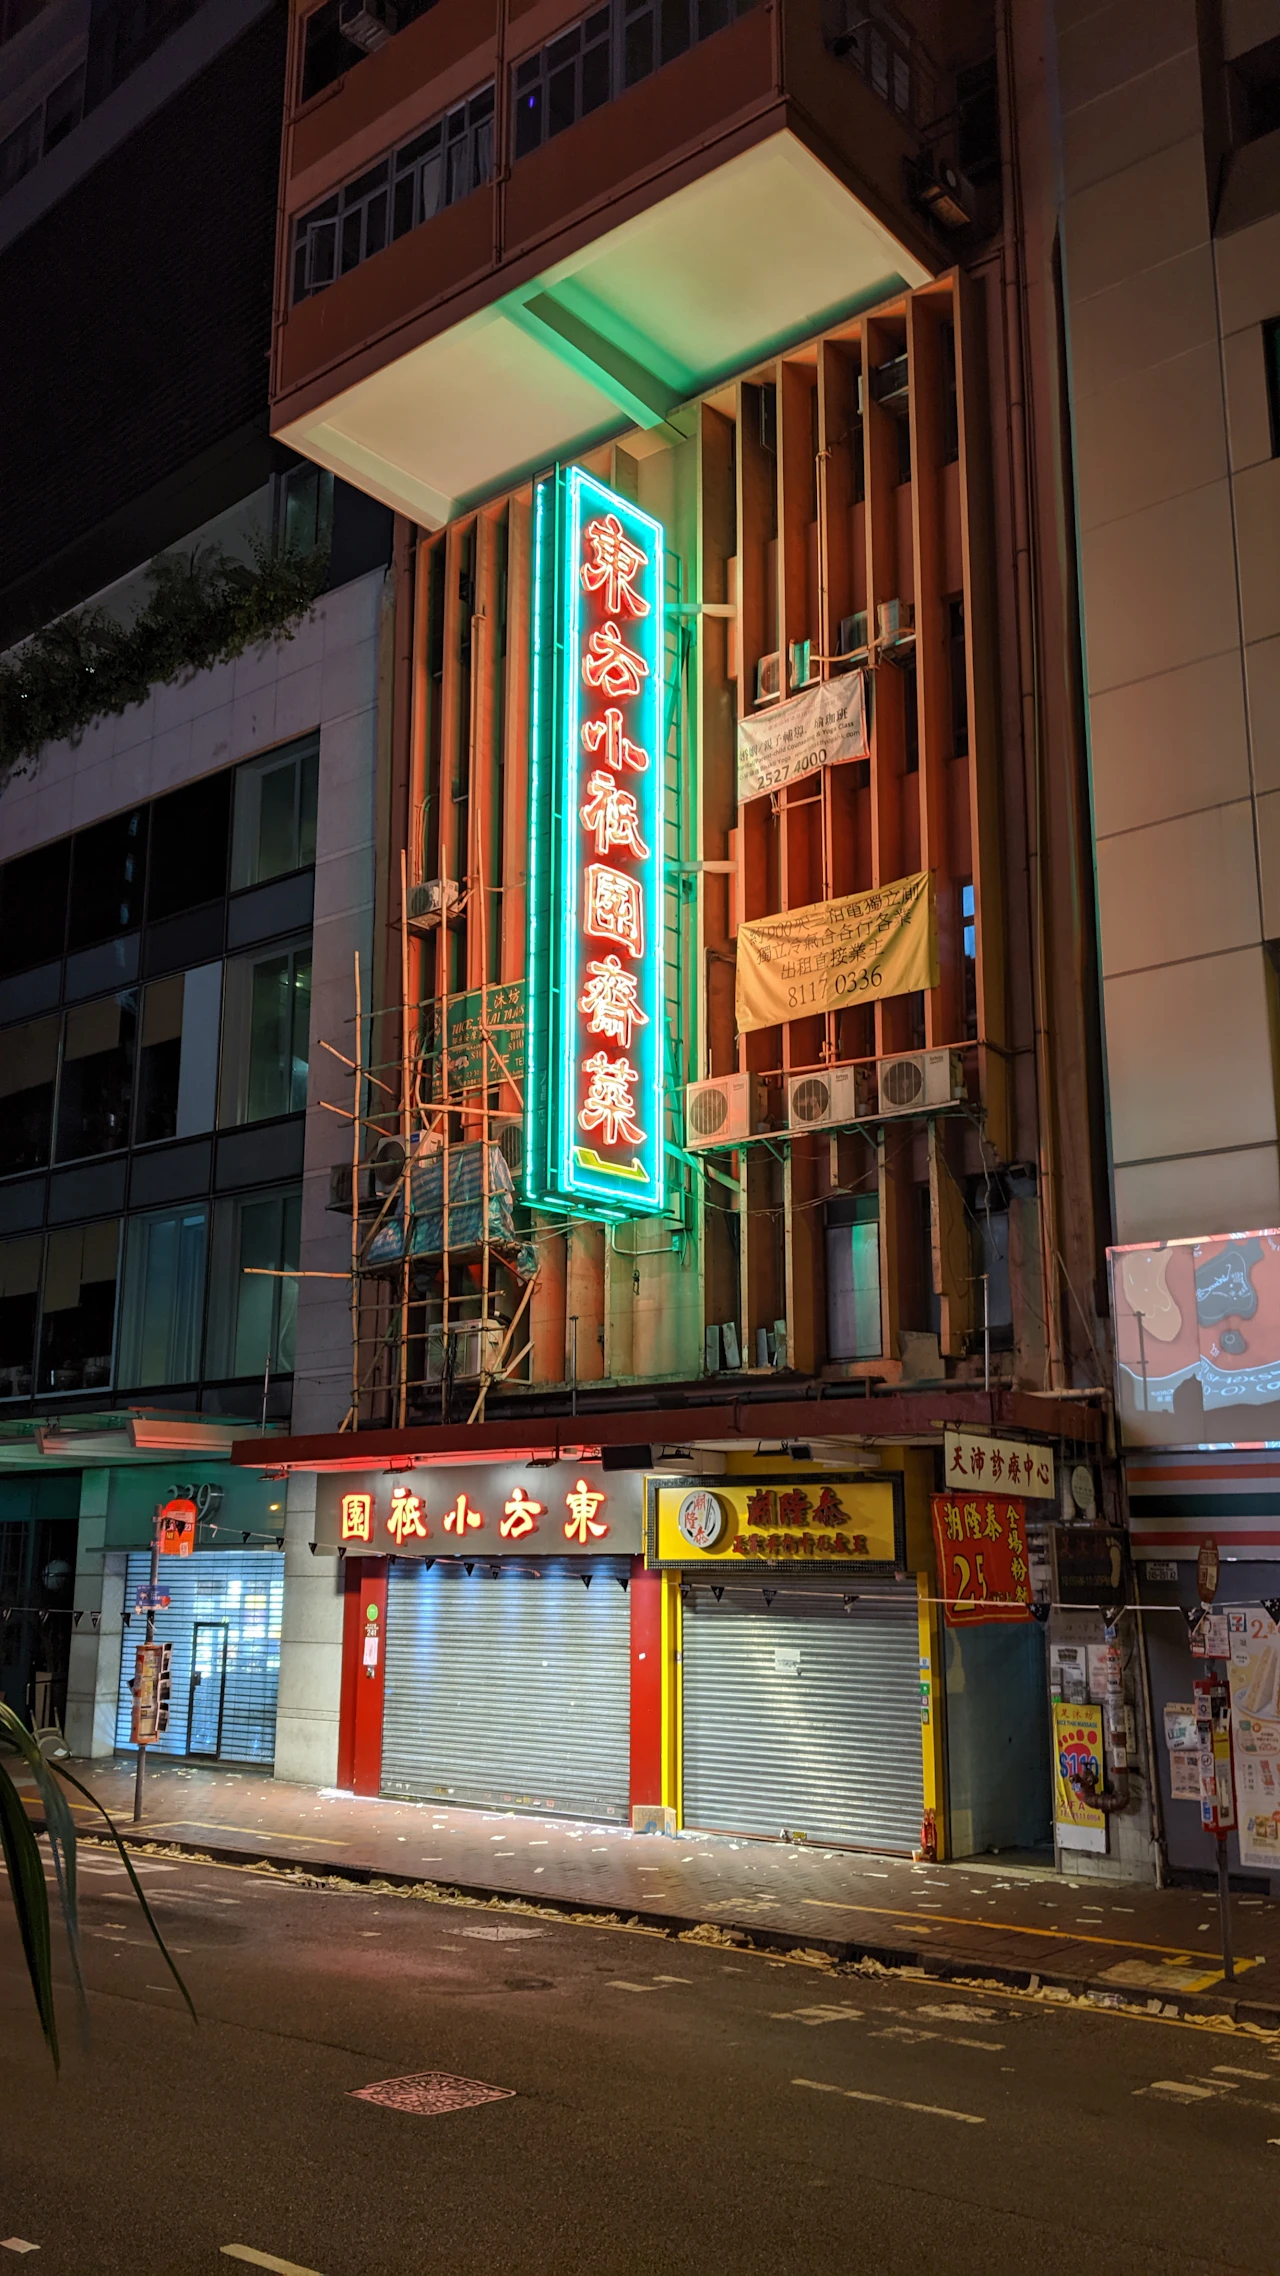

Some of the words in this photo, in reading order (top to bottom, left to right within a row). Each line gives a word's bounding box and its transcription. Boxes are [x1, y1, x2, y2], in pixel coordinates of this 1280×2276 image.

[757, 764, 790, 790] 2527
[793, 748, 827, 773] 4000
[781, 939, 885, 980] 出租直接業主
[788, 976, 828, 1008] 8117
[835, 964, 883, 995] 0336
[943, 1501, 1003, 1542] 潮隆泰
